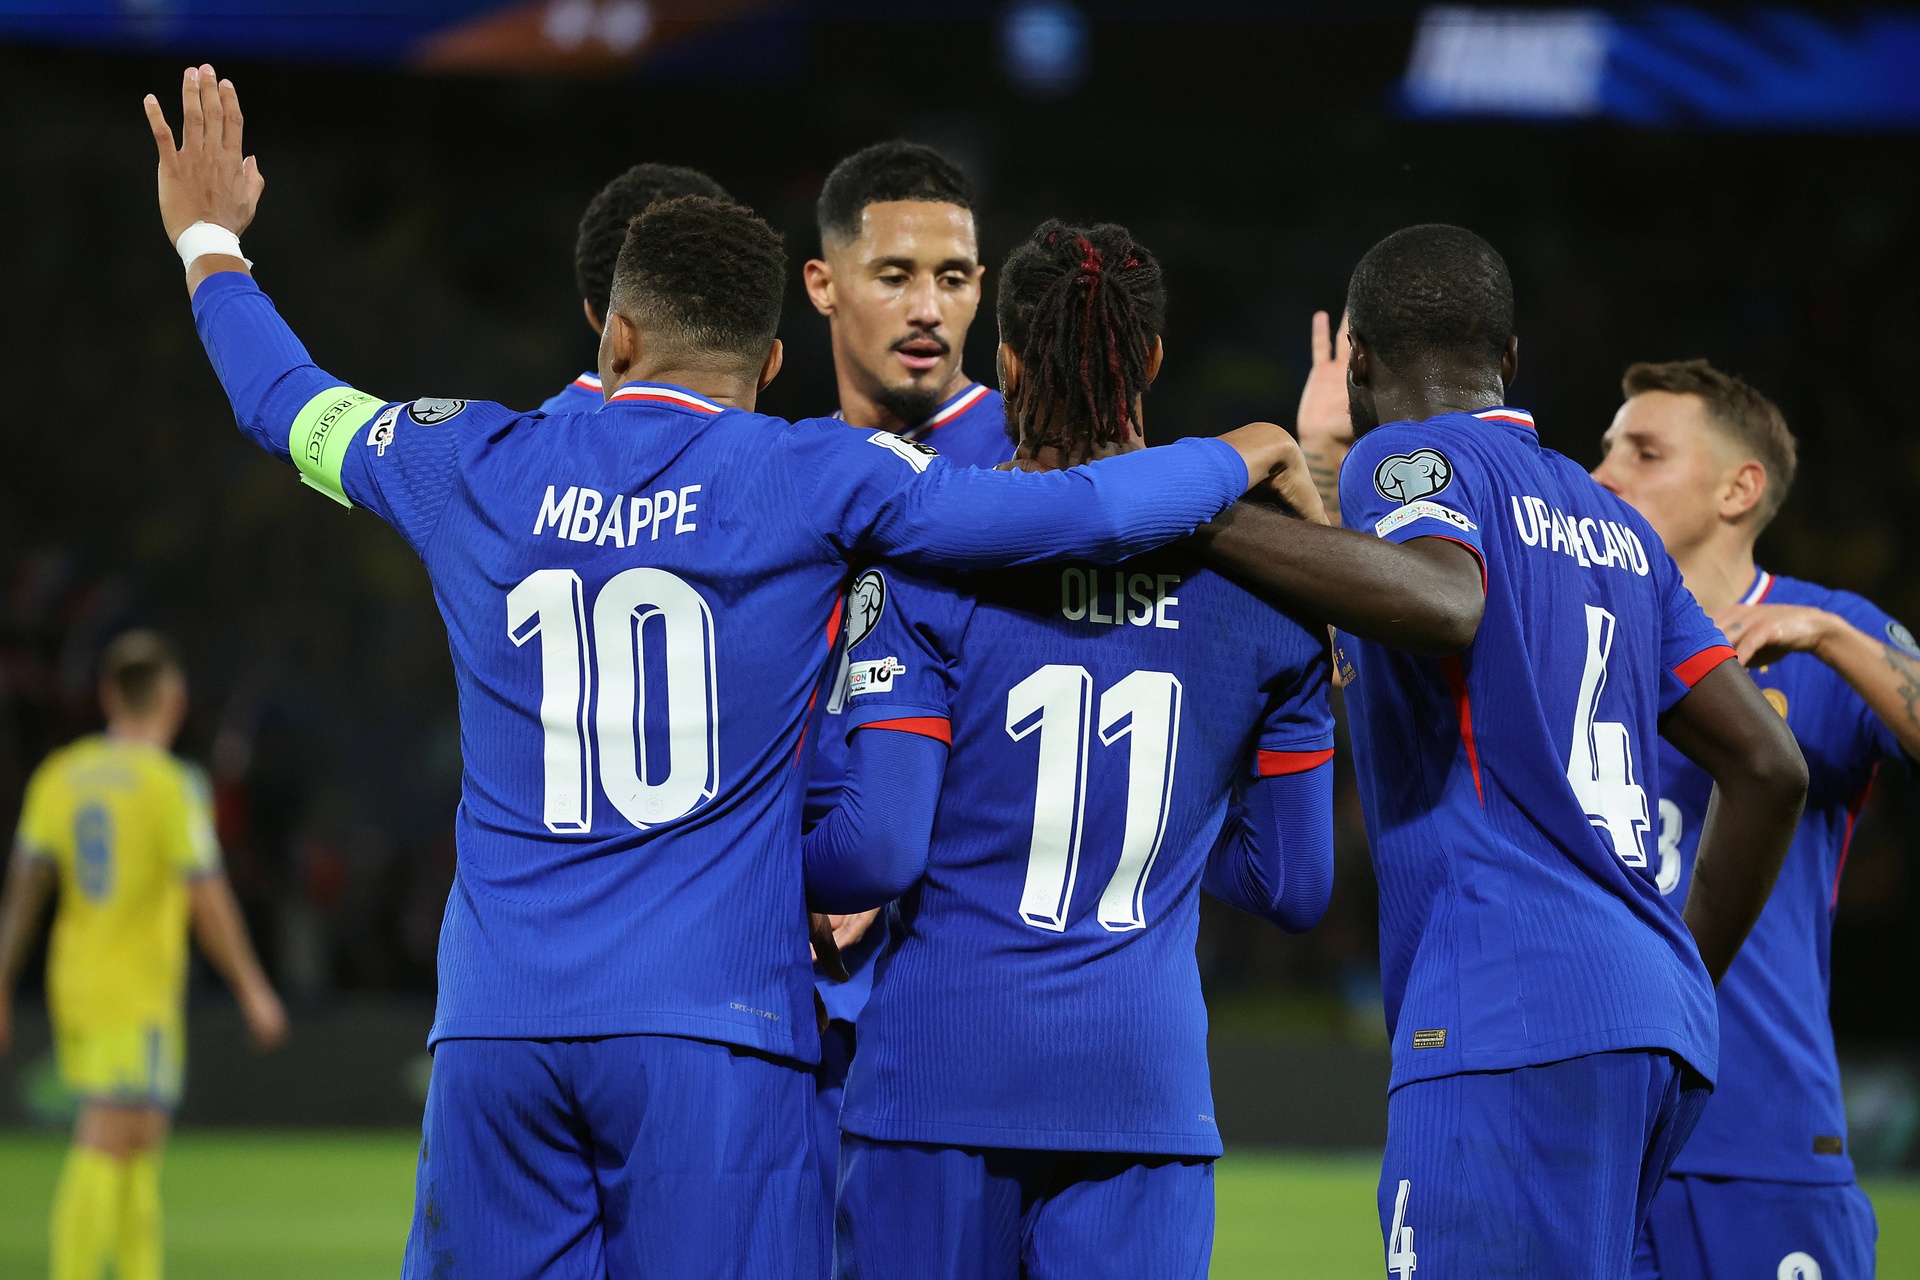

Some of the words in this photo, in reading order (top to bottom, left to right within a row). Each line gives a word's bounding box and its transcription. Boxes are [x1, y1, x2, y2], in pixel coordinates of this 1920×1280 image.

[309, 400, 352, 465] RESPECT
[533, 484, 701, 549] MBAPPE
[1061, 567, 1181, 630] OLISE
[506, 567, 719, 834] 10
[1566, 603, 1650, 868] 4
[1005, 664, 1182, 933] 11
[1388, 1179, 1417, 1280] 4
